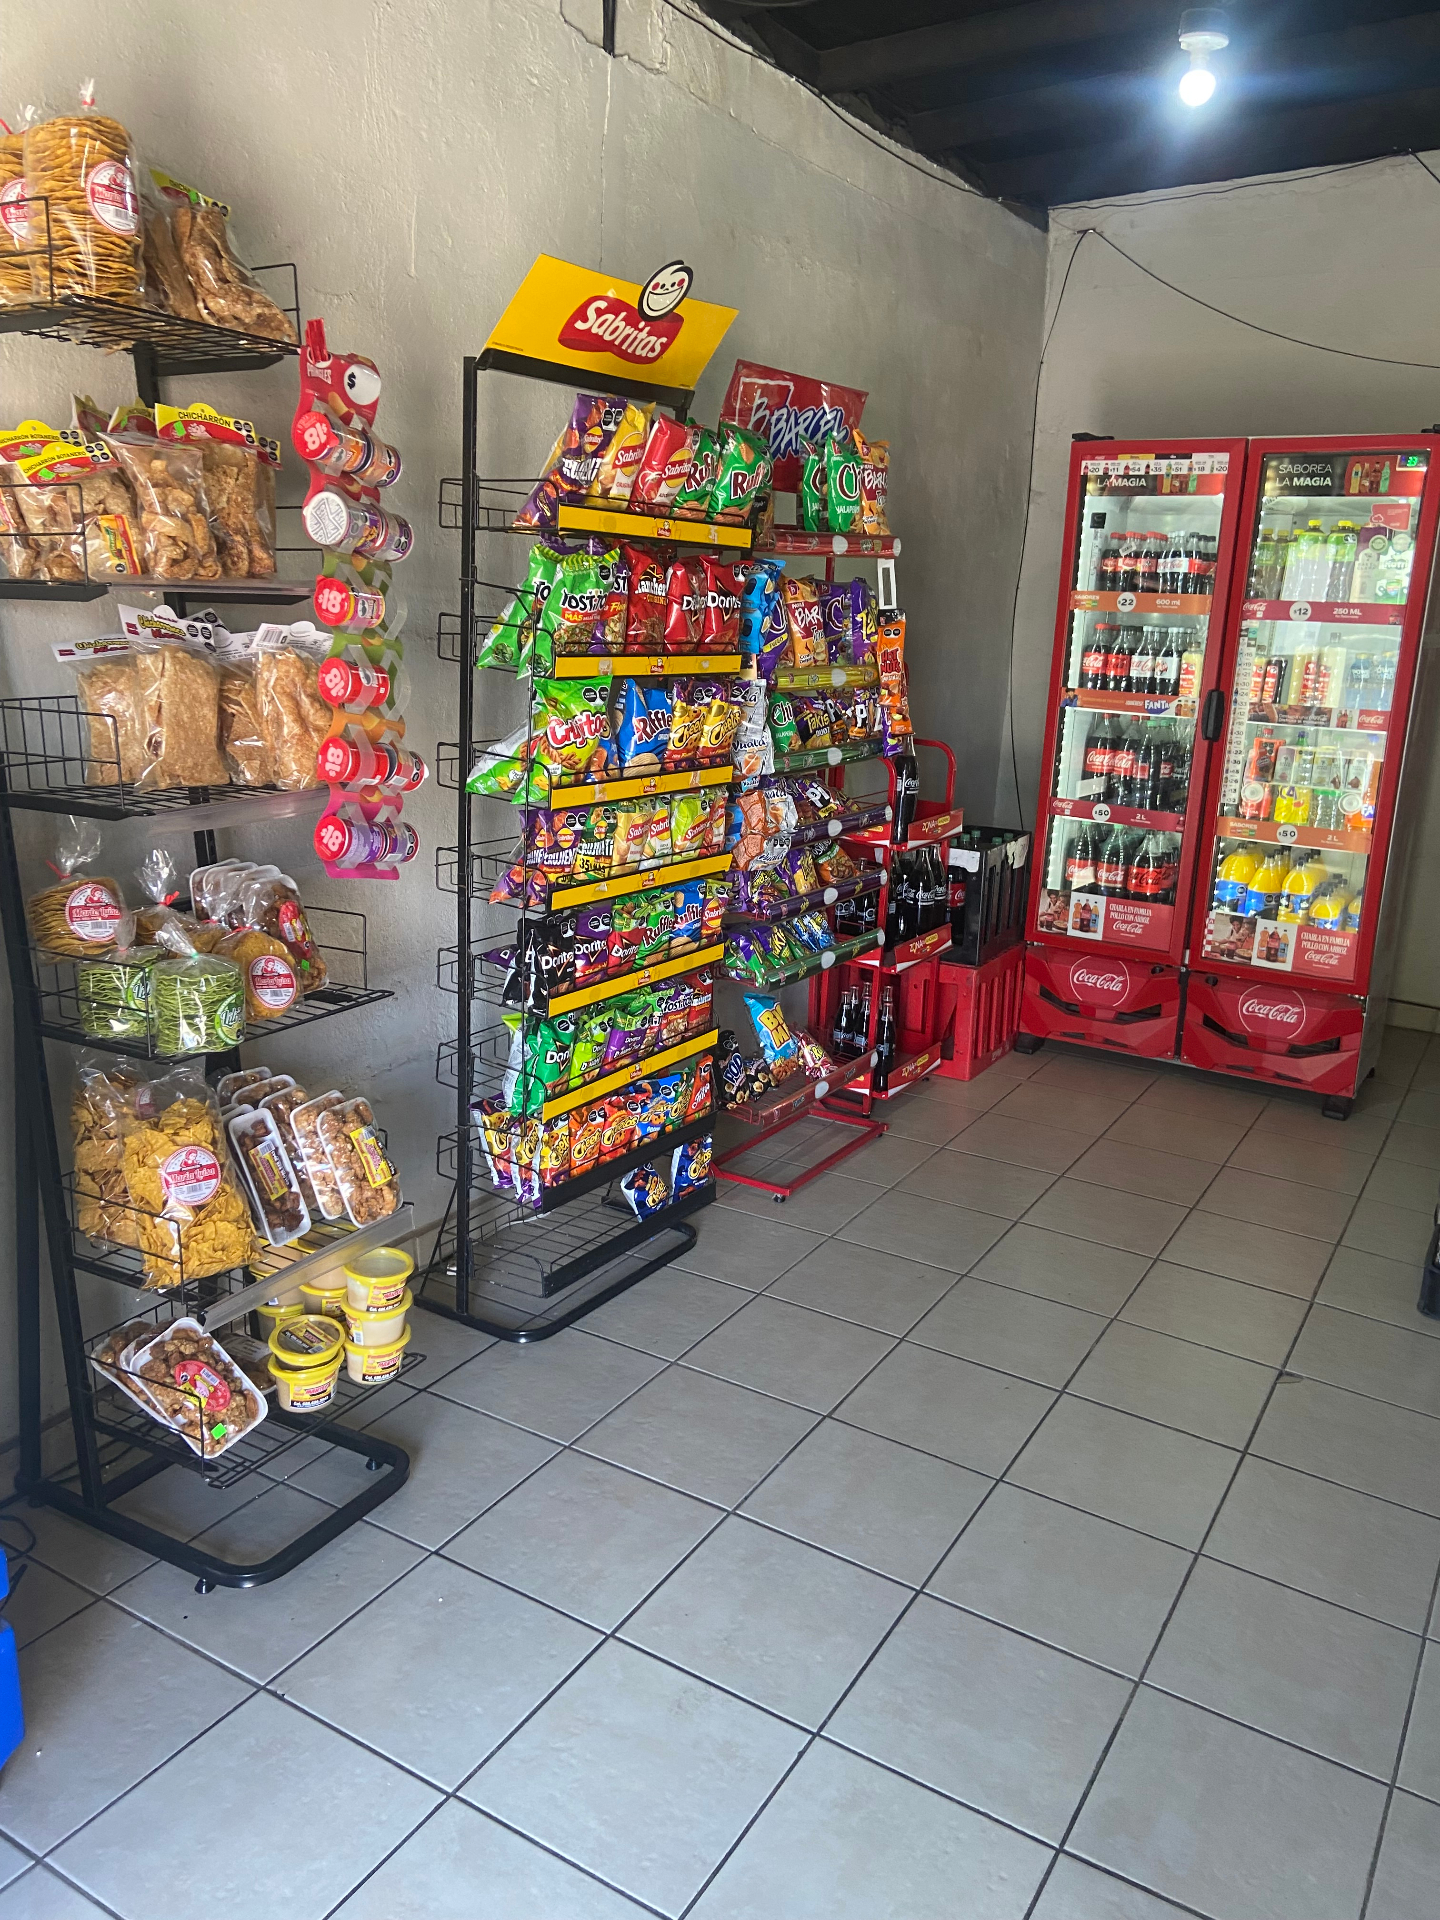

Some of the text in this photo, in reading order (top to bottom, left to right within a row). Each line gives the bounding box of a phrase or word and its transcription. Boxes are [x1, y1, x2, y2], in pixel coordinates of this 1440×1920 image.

[574, 300, 668, 359] Sabritas
[307, 362, 332, 385] PRINGLES
[347, 371, 357, 390] $
[178, 410, 232, 429] CHICHARRÓN
[769, 404, 849, 455] BARCEL
[1278, 464, 1332, 474] SABOREA
[1097, 478, 1147, 487] LA MAGIA
[1275, 477, 1332, 487] LA MAGIA
[532, 577, 551, 602] TO
[318, 591, 346, 614] $18
[559, 587, 609, 613] TOSTITO
[564, 610, 583, 622] MÁS
[1293, 607, 1308, 615] $12
[1349, 607, 1362, 615] ML
[880, 647, 900, 664] HOT
[880, 660, 902, 676] NUTS
[547, 710, 608, 749] Crujito
[804, 711, 832, 734] Takis
[732, 735, 768, 752] Vualá
[320, 824, 345, 853] $18
[1109, 912, 1124, 921] POLLO
[1124, 913, 1134, 922] CON
[1113, 921, 1144, 934] Coca-Cola
[574, 939, 607, 956] Dorito
[1300, 931, 1350, 947] CHARLA EN FAMILIA
[1300, 940, 1318, 951] POLLO
[1318, 943, 1329, 952] CON
[541, 949, 574, 971] Dorito
[1304, 950, 1339, 965] Coca-Cola
[1073, 968, 1123, 992] Coca-Cola
[1242, 999, 1300, 1024] Coca-Cola
[723, 1052, 744, 1084] POP
